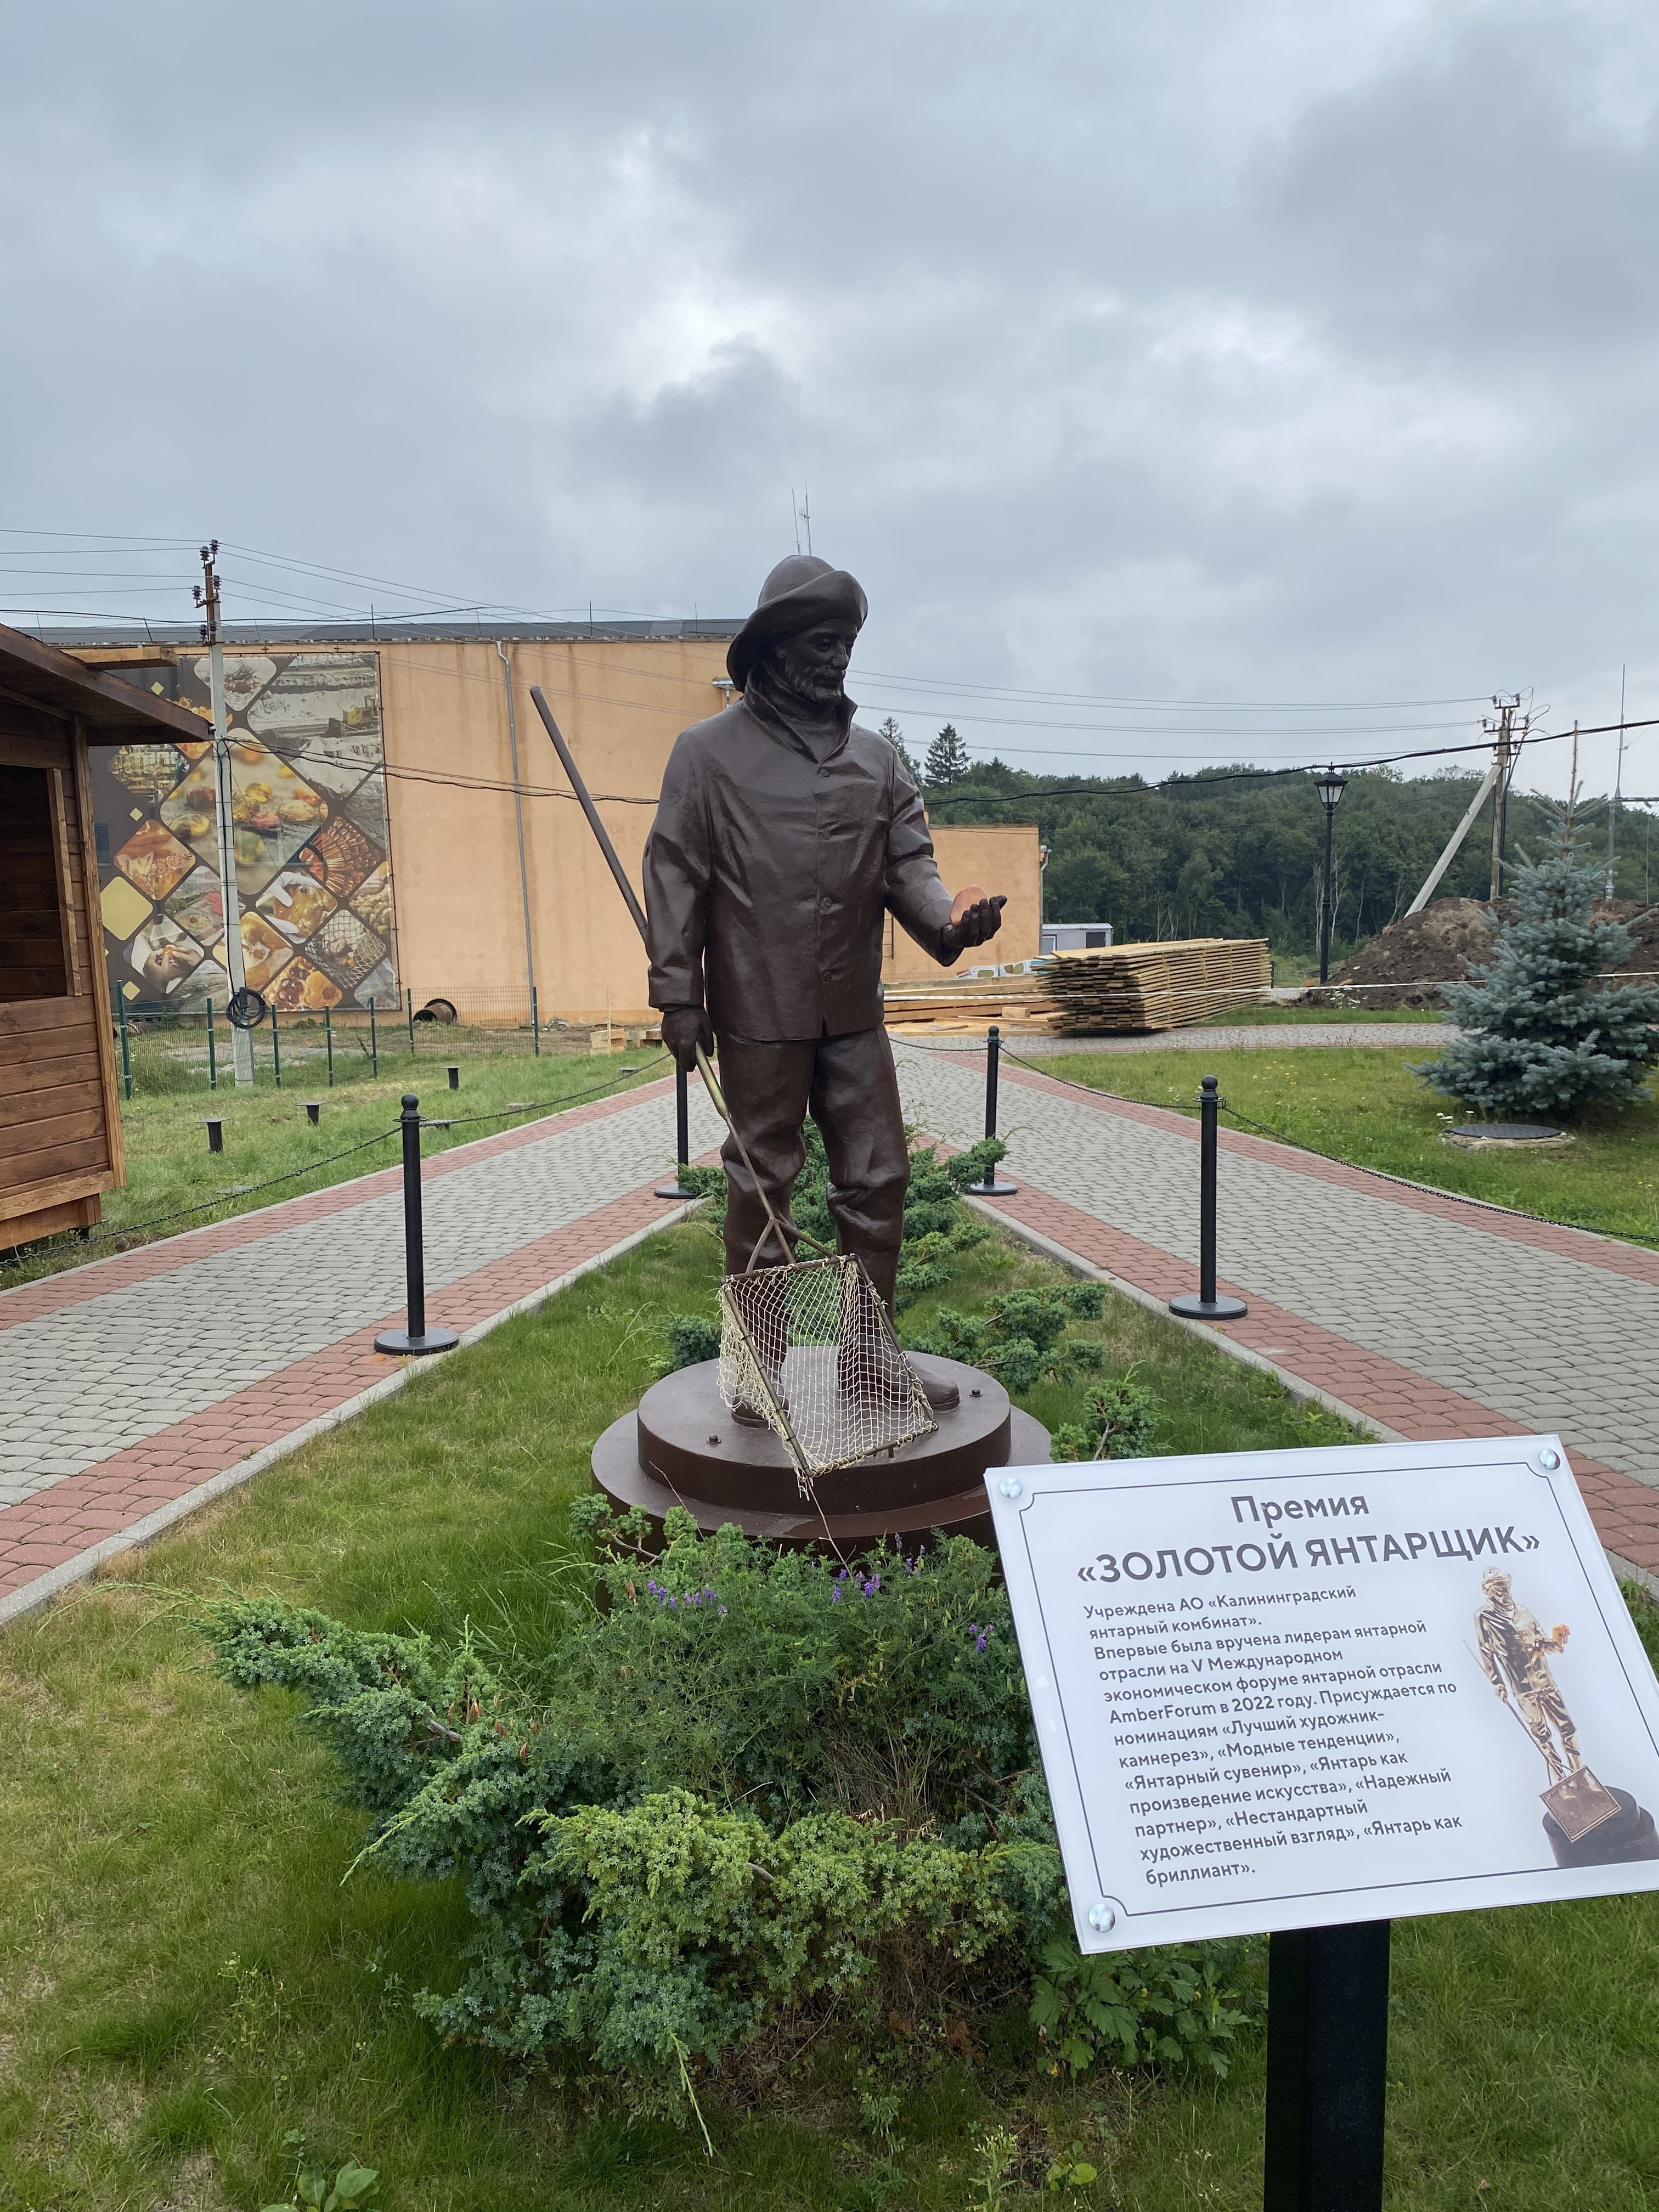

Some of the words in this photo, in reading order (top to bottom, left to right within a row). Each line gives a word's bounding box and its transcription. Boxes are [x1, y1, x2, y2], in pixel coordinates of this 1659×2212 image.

[1230, 1495, 1370, 1529] Премия
[1077, 1532, 1299, 1583] «ЗОЛОТОЙ
[1305, 1526, 1540, 1567] ЯНТАРЩИК»
[1083, 1602, 1176, 1621] Учреждена
[1180, 1596, 1204, 1611] АО
[1208, 1584, 1357, 1608] «Калининградский
[1089, 1620, 1169, 1640] янтарный
[1171, 1616, 1262, 1632] комбинат».
[1093, 1644, 1167, 1661] Впервые
[1171, 1639, 1213, 1653] была
[1215, 1635, 1281, 1652] вручена
[1284, 1629, 1352, 1644] лидерам
[1354, 1620, 1427, 1639] янтарной
[1099, 1666, 1166, 1683] отрасли
[1169, 1664, 1189, 1675] на
[1190, 1658, 1203, 1672] V
[1207, 1650, 1344, 1671] Международном
[1103, 1681, 1233, 1702] экономическом
[1236, 1675, 1299, 1694] форуме
[1301, 1664, 1376, 1685] янтарной
[1379, 1663, 1442, 1680] отрасли
[1110, 1704, 1216, 1724] AmberForum
[1220, 1703, 1229, 1713] в
[1231, 1695, 1275, 1712] 2022
[1277, 1695, 1317, 1709] году.
[1318, 1685, 1435, 1707] Присуждается
[1437, 1683, 1457, 1694] по
[1114, 1726, 1218, 1746] номинациям
[1222, 1715, 1297, 1737] «Лучший
[1299, 1711, 1384, 1731] художник-
[1119, 1750, 1214, 1768] камнерез»,
[1217, 1741, 1295, 1757] «Модные
[1297, 1733, 1400, 1750] тенденции»,
[1125, 1767, 1220, 1790] «Янтарный
[1223, 1764, 1306, 1784] сувенир»,
[1310, 1756, 1378, 1771] «Янтарь
[1379, 1752, 1409, 1765] как
[1129, 1791, 1252, 1817] произведение
[1255, 1782, 1352, 1802] искусства»,
[1355, 1768, 1452, 1790] «Надежный
[1135, 1819, 1222, 1839] партнер»,
[1226, 1798, 1368, 1826] «Нестандартный
[1139, 1830, 1288, 1864] художественный
[1290, 1828, 1360, 1844] взгляд»,
[1363, 1820, 1431, 1836] «Янтарь
[1434, 1816, 1463, 1830] как
[1146, 1864, 1255, 1888] бриллиант».
